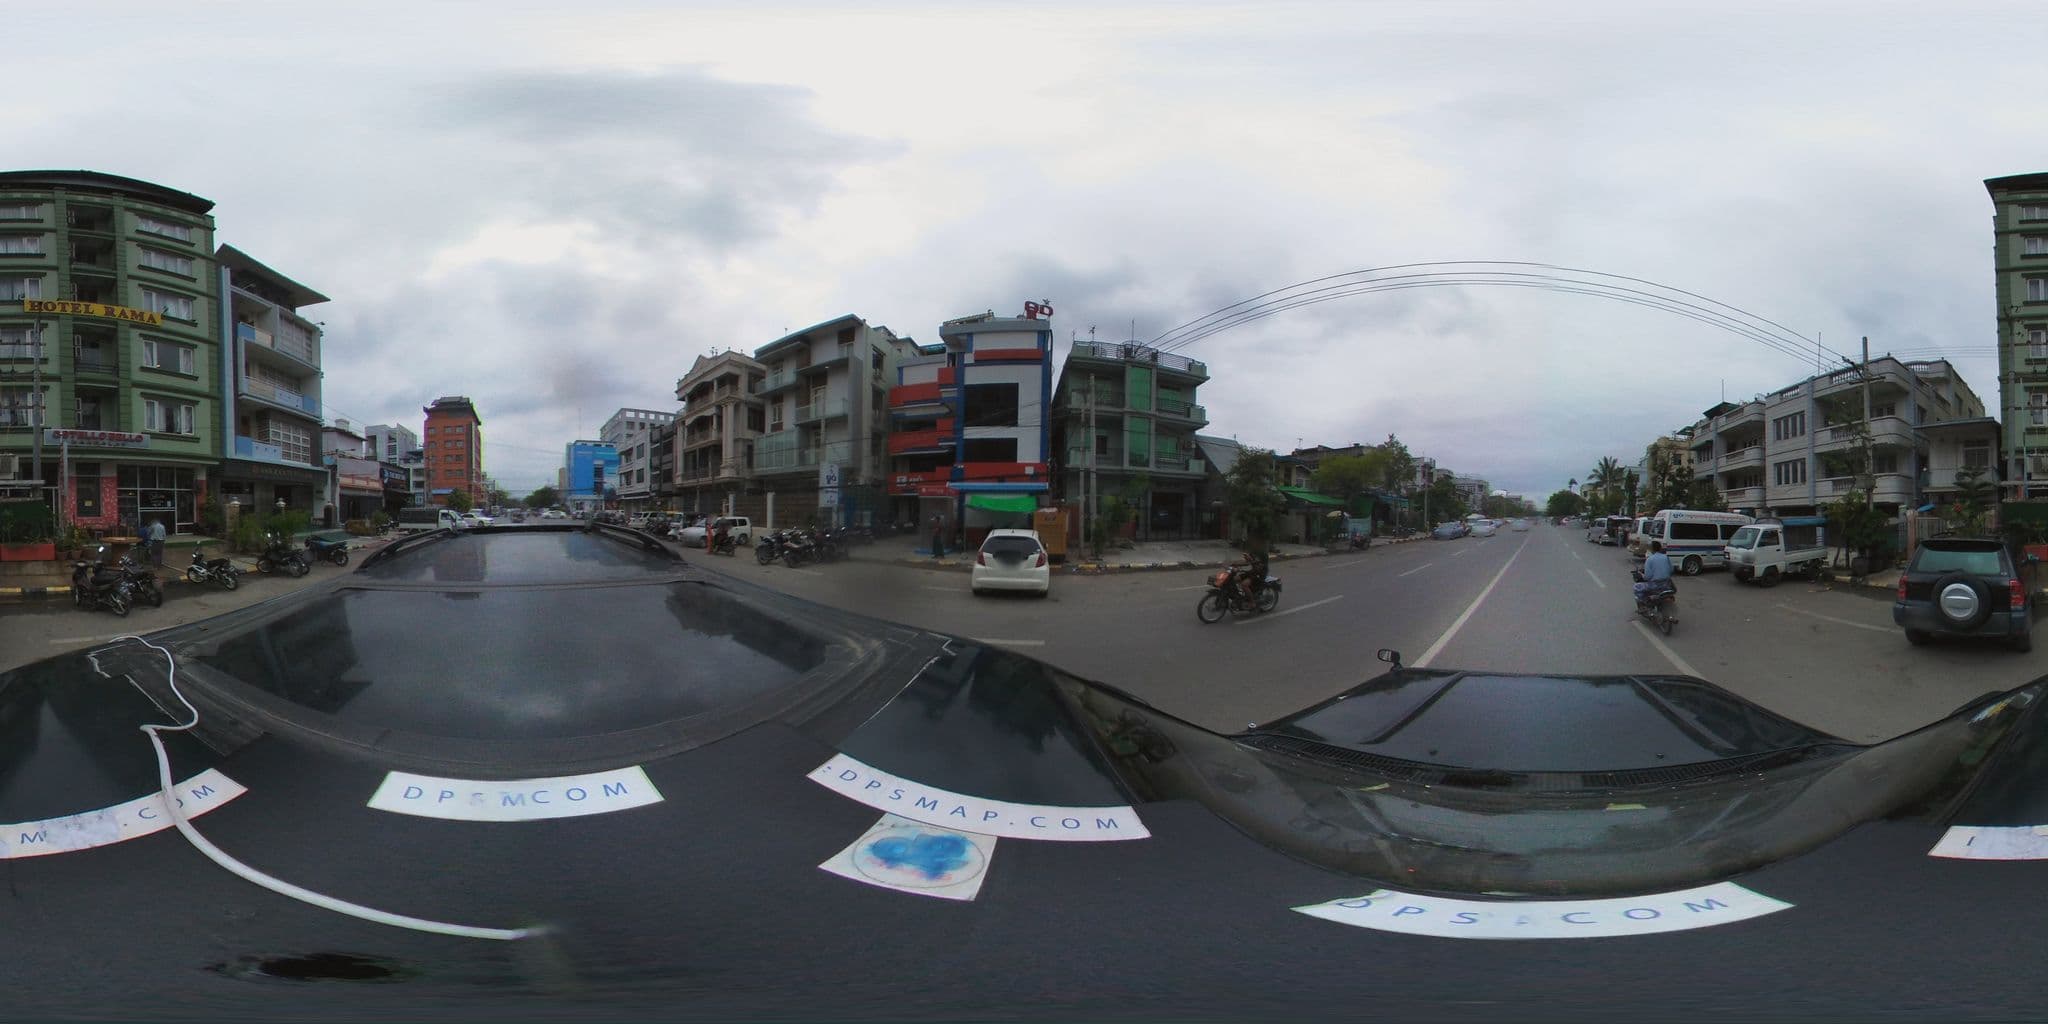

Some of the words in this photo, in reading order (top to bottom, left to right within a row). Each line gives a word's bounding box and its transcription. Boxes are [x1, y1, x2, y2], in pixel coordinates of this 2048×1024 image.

[28, 300, 95, 314] HOTEL
[103, 305, 158, 324] RAMA
[839, 769, 1119, 830] DPSMAP.COM
